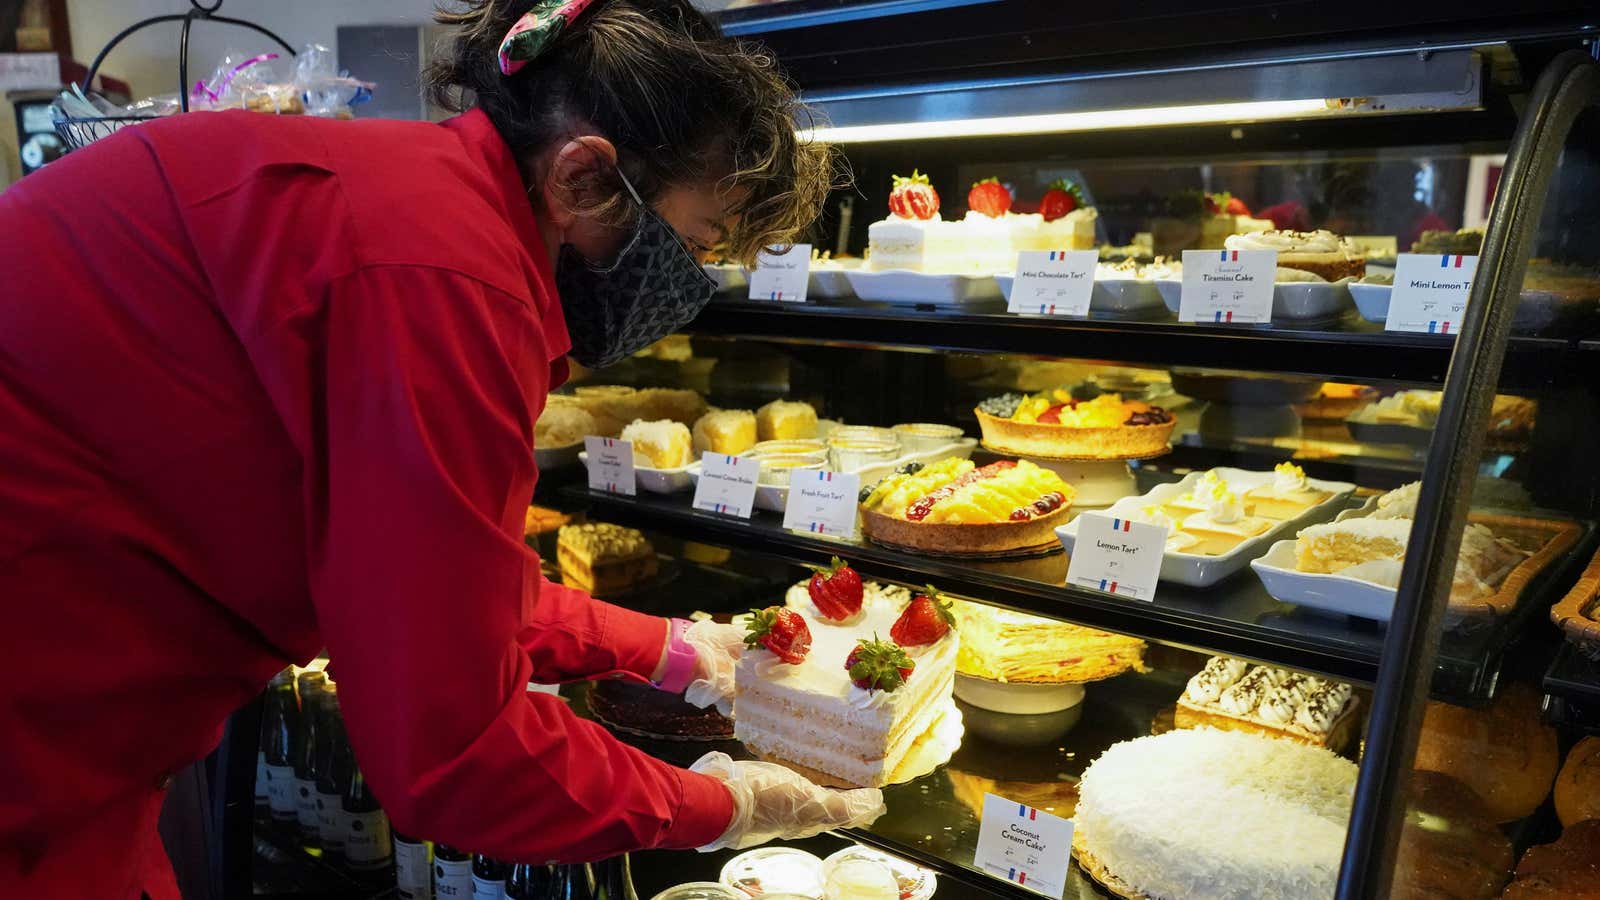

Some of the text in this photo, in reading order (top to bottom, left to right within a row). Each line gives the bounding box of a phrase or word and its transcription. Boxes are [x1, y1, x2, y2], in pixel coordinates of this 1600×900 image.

[1038, 271, 1069, 279] Chocolate
[1203, 274, 1254, 282] Tiramisu Cake
[1410, 280, 1430, 288] Mini
[1431, 281, 1461, 290] Lemon
[801, 488, 816, 497] Fresh
[816, 491, 830, 499] Fruit
[1097, 540, 1120, 551] Lemon
[1001, 830, 1025, 845] Cream
[1010, 823, 1040, 841] Coconut
